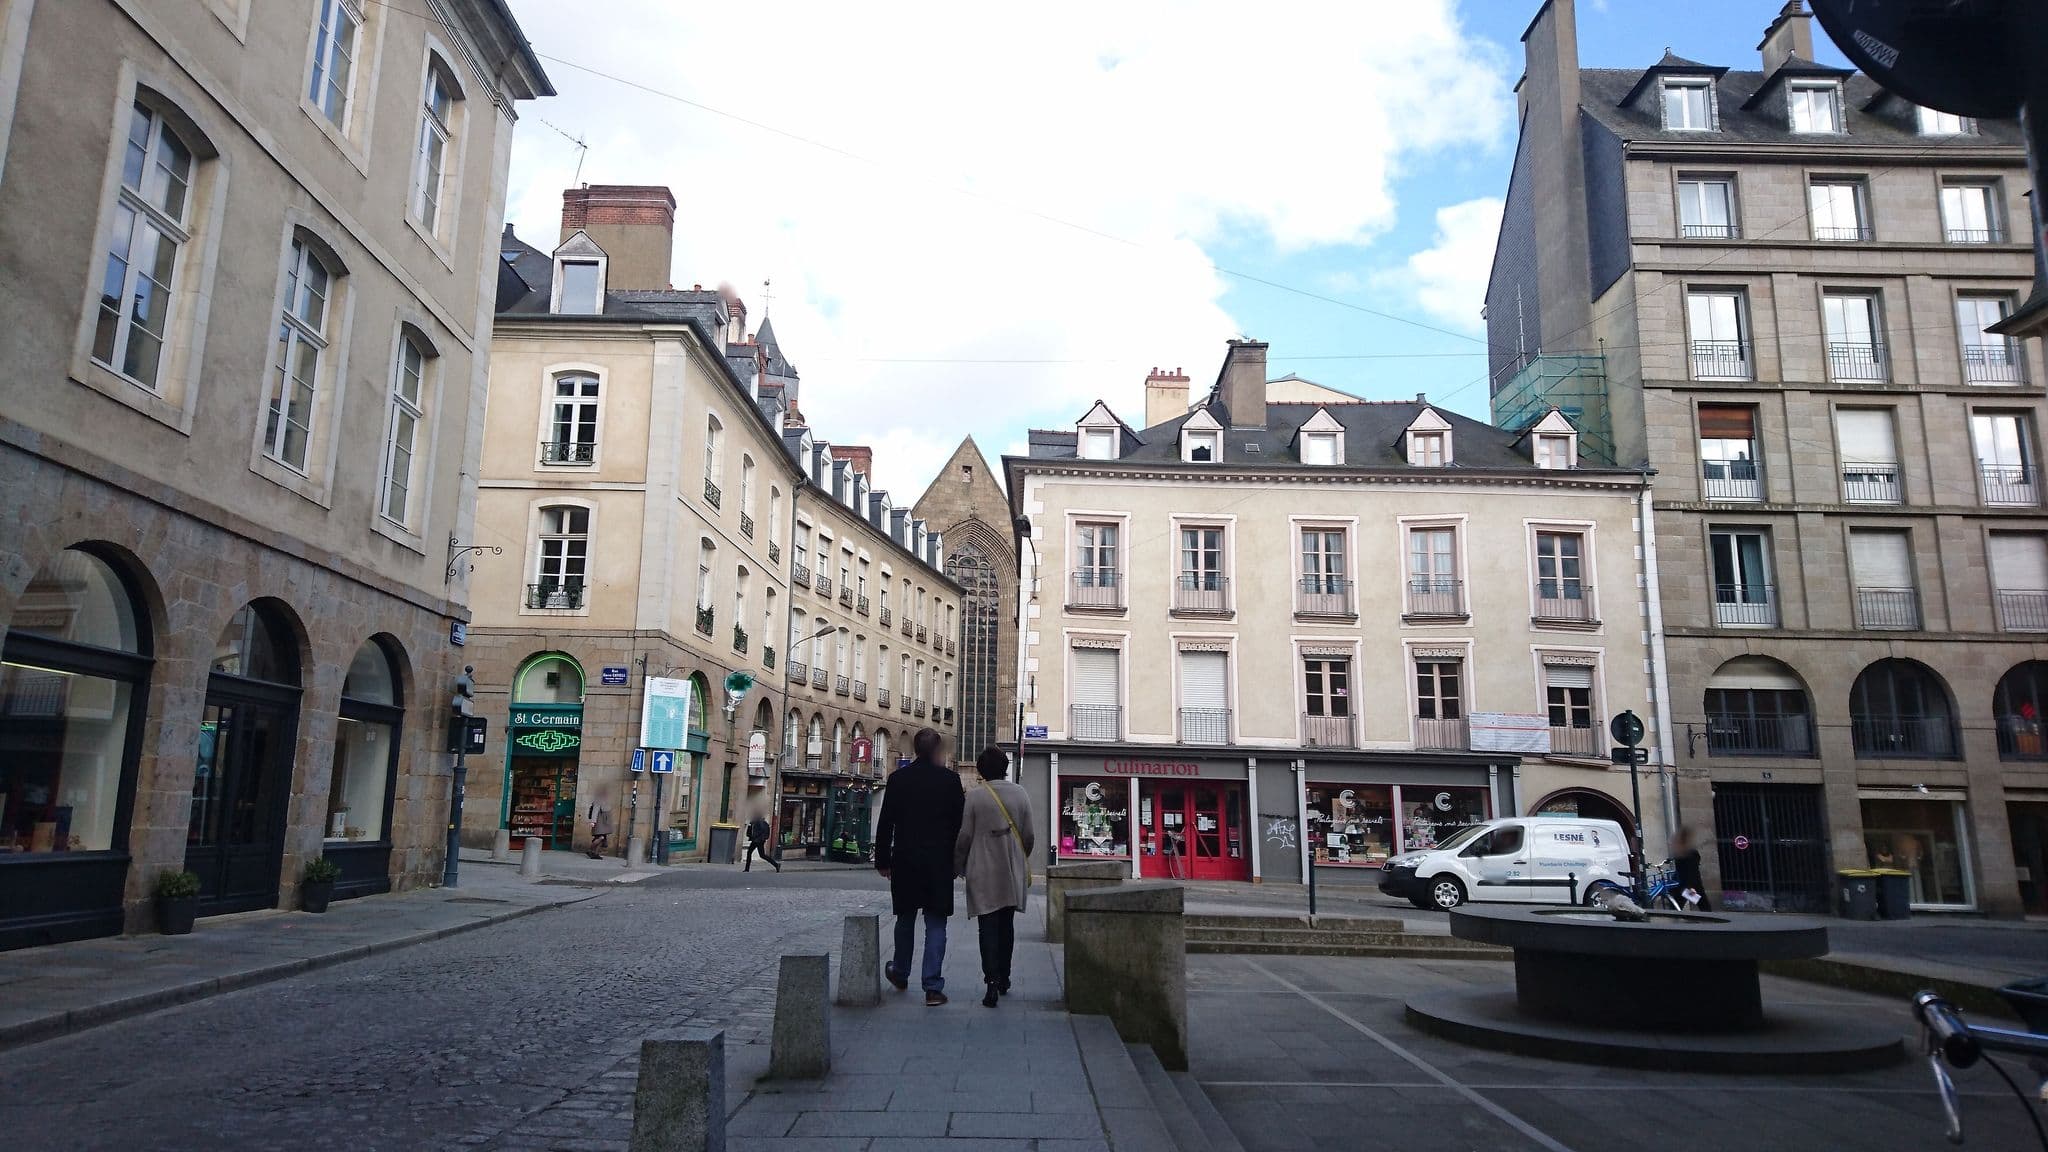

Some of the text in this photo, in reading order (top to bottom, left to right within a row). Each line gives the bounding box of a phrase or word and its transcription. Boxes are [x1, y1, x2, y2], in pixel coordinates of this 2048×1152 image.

[514, 712, 580, 725] St Germain
[1103, 758, 1199, 776] Culinarion
[1554, 832, 1584, 842] LESNÉ
